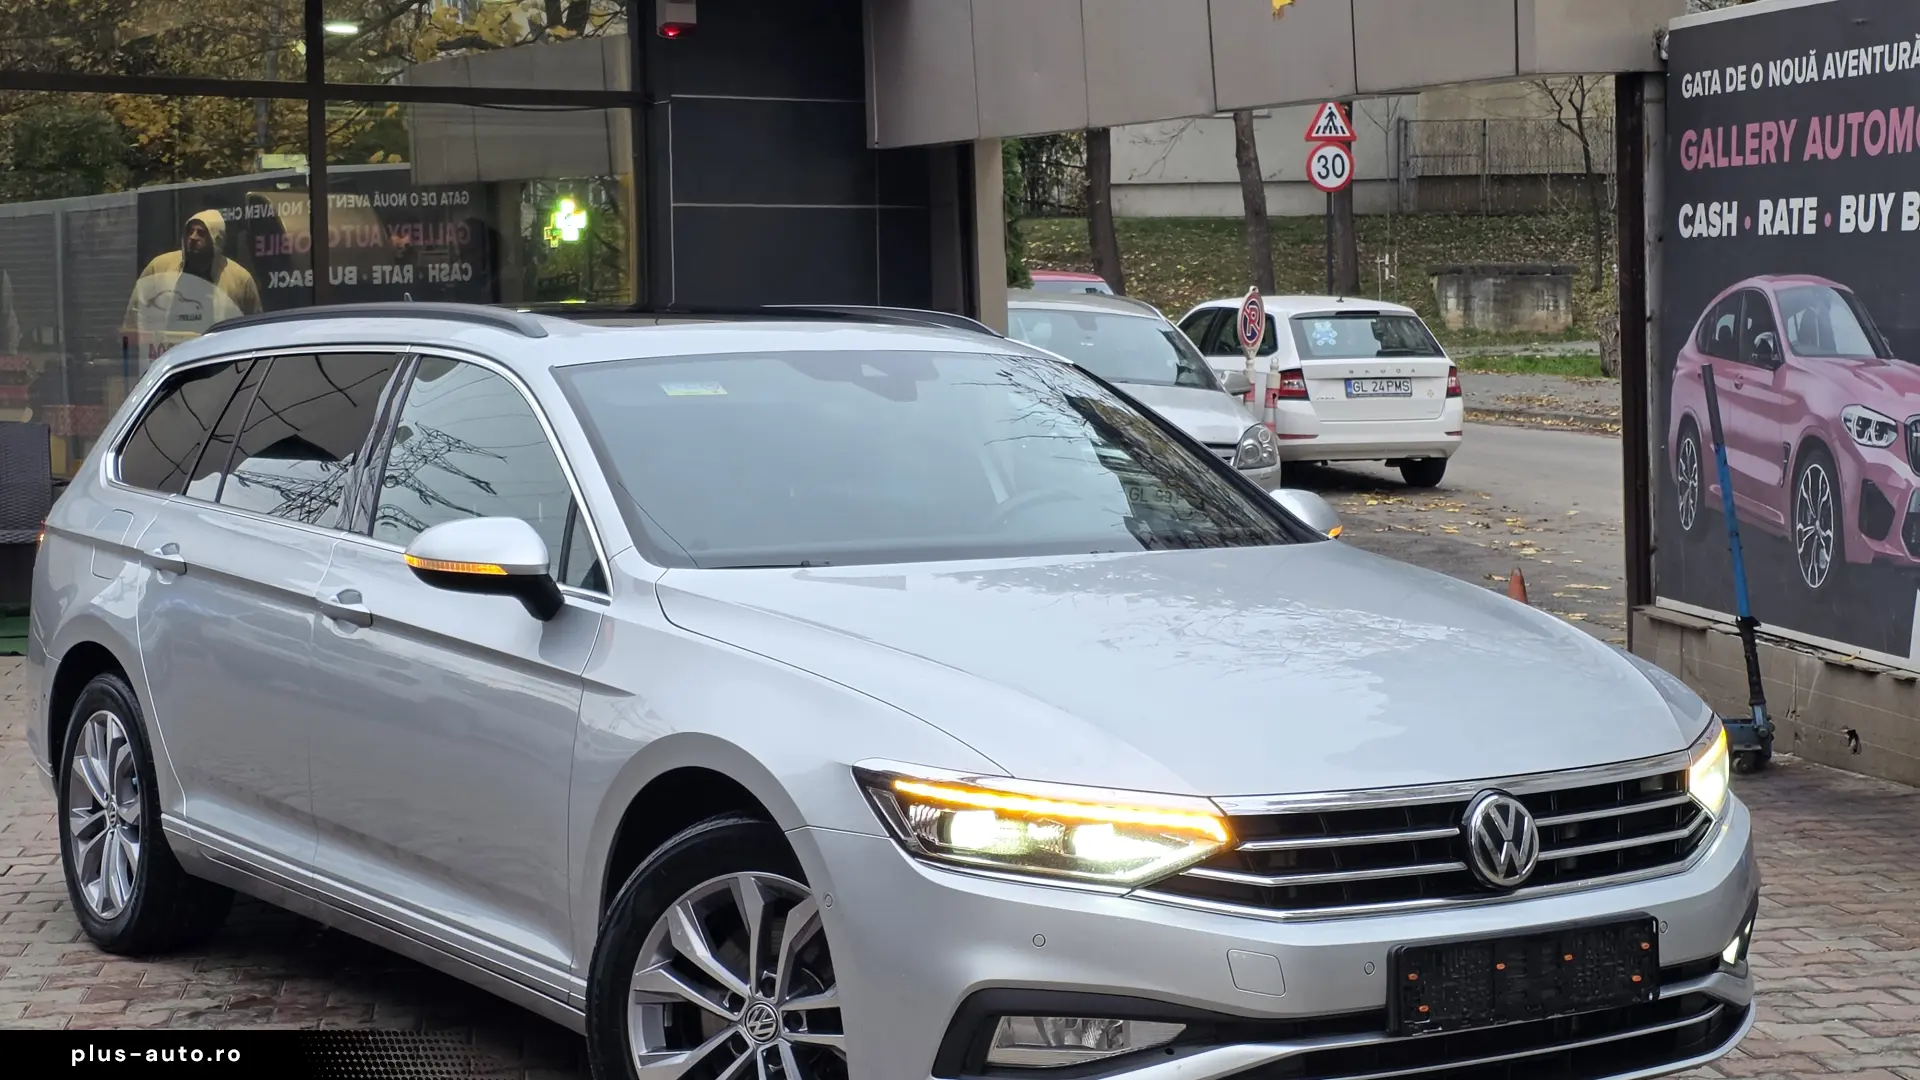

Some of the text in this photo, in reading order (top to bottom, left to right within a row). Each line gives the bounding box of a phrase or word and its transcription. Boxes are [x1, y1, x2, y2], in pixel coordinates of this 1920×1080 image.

[1682, 69, 1721, 98] GATA
[1725, 63, 1746, 92] DE
[1751, 62, 1763, 89] O
[1768, 50, 1818, 88] NOUĂ
[1680, 106, 1920, 171] GALLERY AUTOM
[1316, 153, 1345, 180] 30
[1678, 191, 1920, 238] CASH RATE BUY B
[1352, 381, 1410, 393] GL 24 PMS
